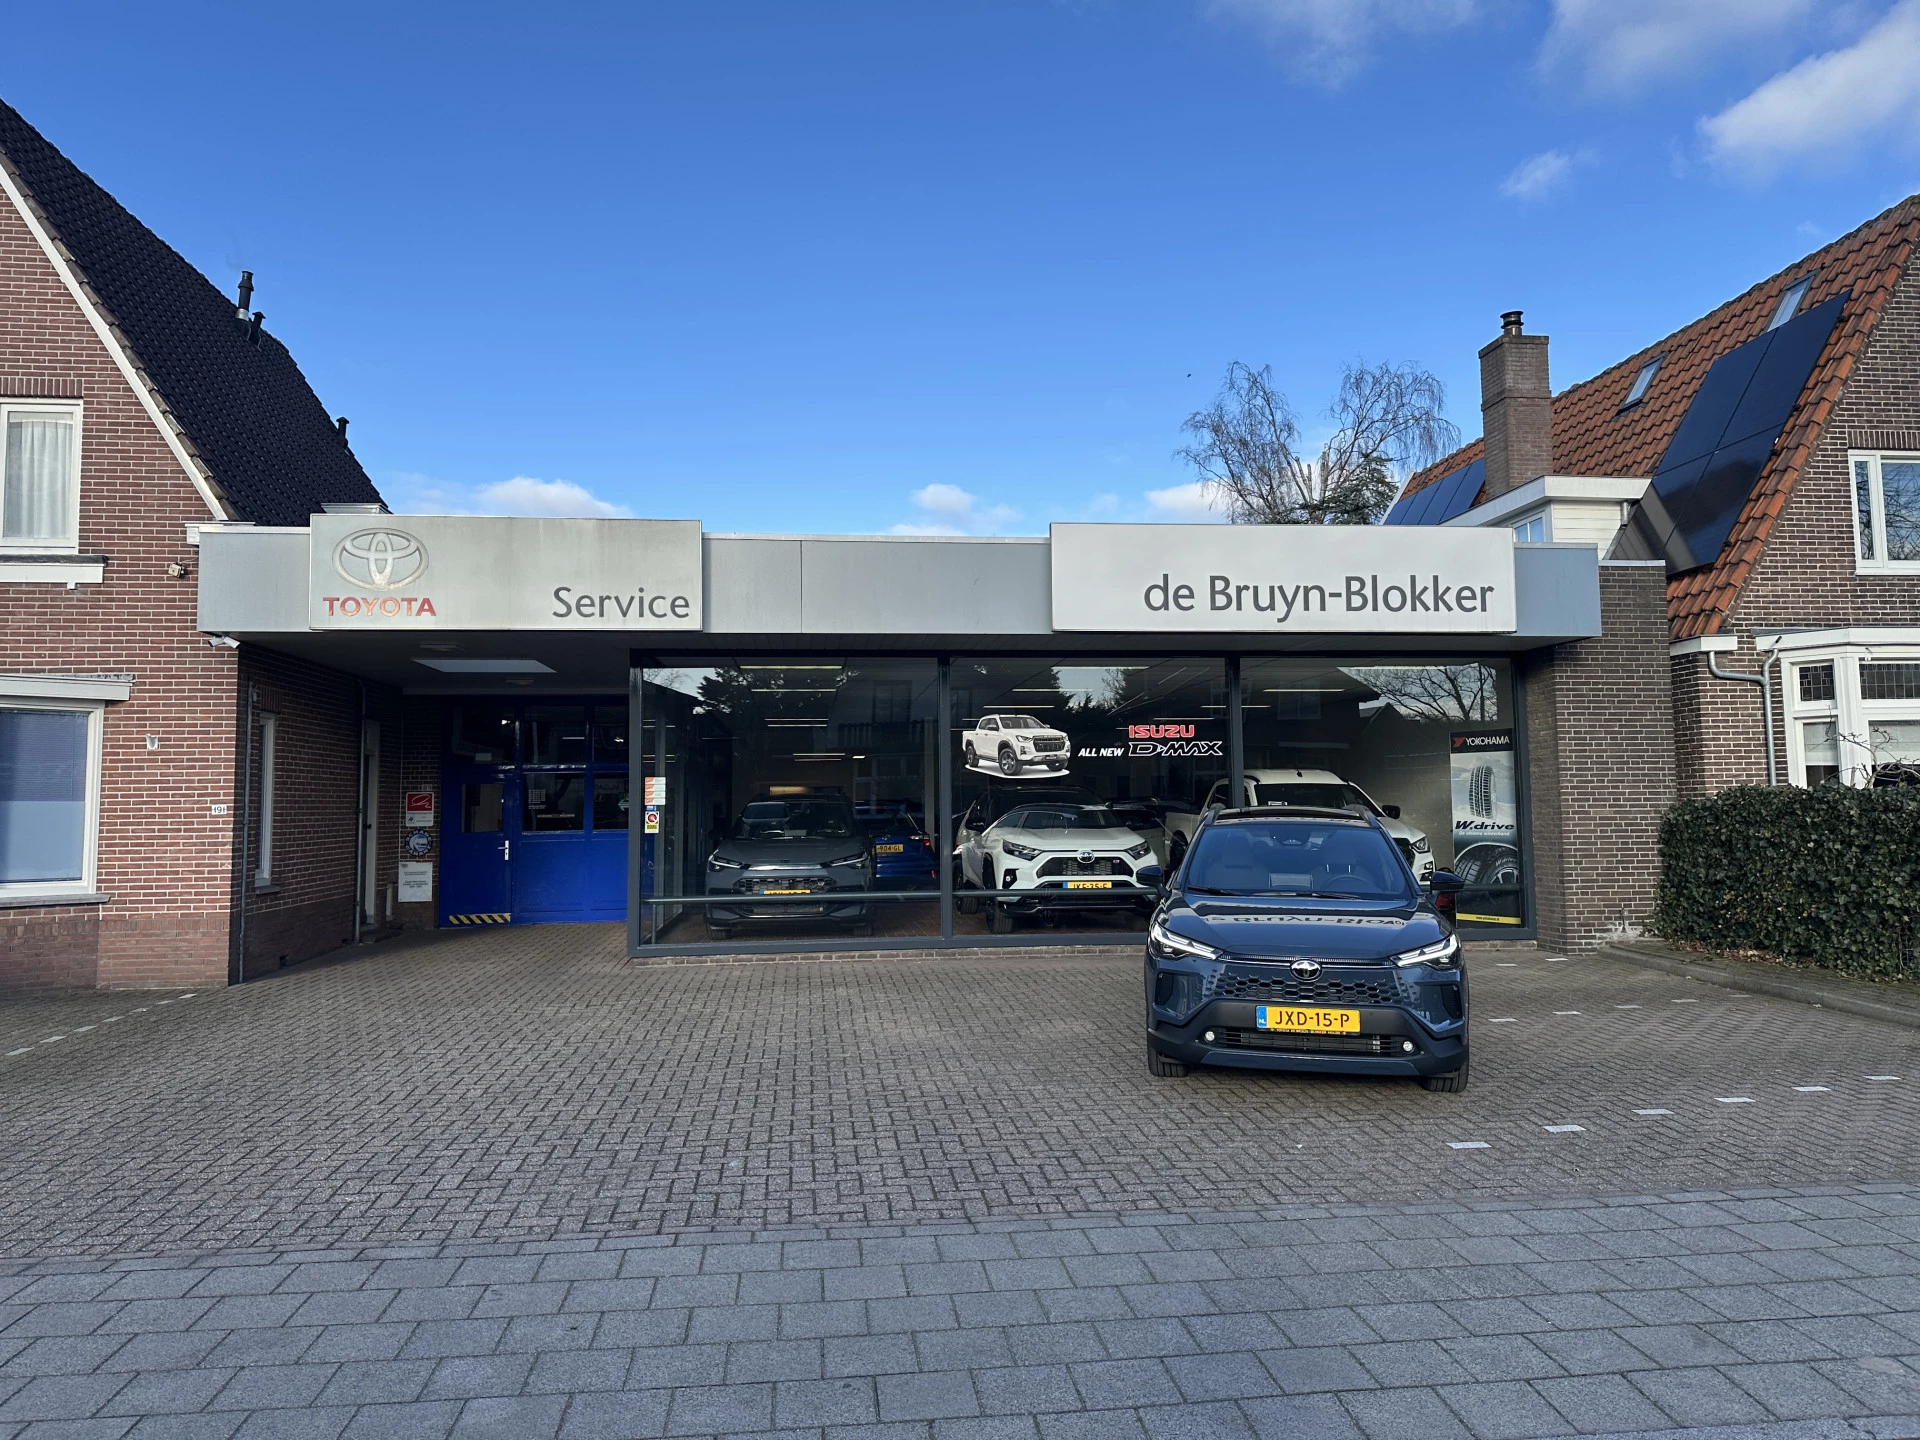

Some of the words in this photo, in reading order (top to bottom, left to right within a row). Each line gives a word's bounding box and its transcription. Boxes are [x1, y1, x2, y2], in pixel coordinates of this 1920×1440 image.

[323, 597, 437, 617] TOYOTA
[552, 586, 690, 619] Service
[1144, 574, 1195, 612] de
[1209, 574, 1495, 624] Bruyn-Blokker
[1128, 725, 1195, 739] ISUZU
[1465, 735, 1510, 746] YOKOHAMA
[1078, 747, 1100, 757] ALL
[1100, 747, 1125, 757] NEW
[1455, 820, 1515, 830] W.drive
[1275, 1010, 1350, 1028] JXD-15-P
